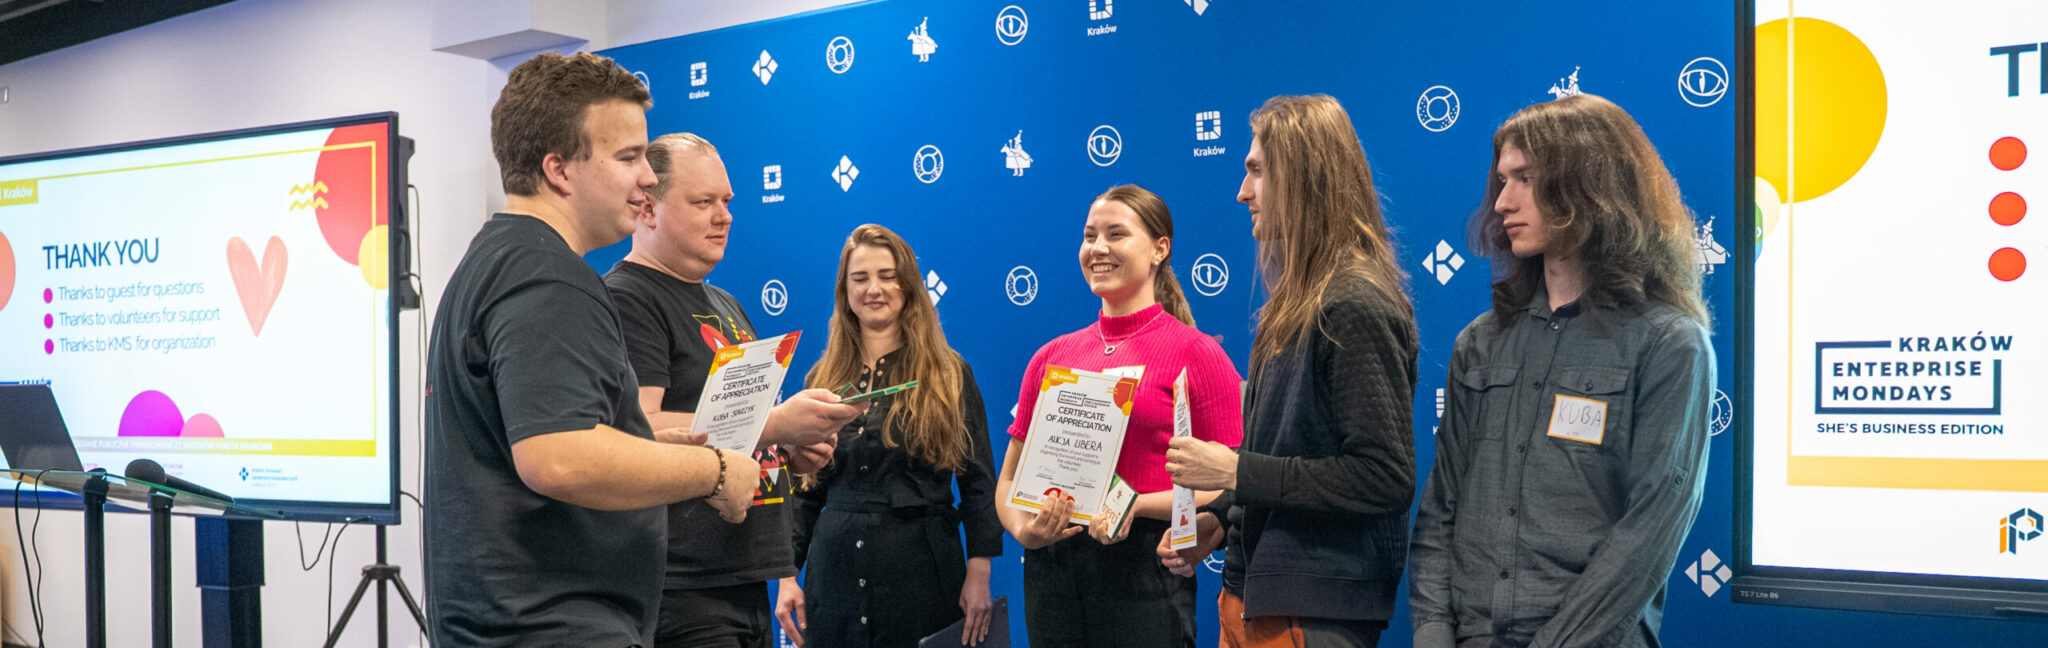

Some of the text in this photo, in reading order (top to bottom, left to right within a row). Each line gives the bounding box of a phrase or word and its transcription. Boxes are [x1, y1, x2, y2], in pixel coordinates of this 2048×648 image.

[1087, 24, 1117, 36] Kraków
[1990, 42, 2048, 97] T
[1193, 146, 1226, 157] Kraków
[3, 185, 33, 200] Kraków
[42, 237, 159, 270] THANK YOU
[58, 281, 205, 303] Thanks to guest for questions
[58, 306, 221, 327] Thanks to volunteers for support
[59, 335, 217, 354] Thanks to KMS for organization
[1898, 331, 2013, 352] KRAKÓW
[1832, 361, 1982, 377] ENTERPRISE
[711, 382, 771, 402] OF APPRECIATION
[722, 375, 766, 391] CERTIFICATE
[1832, 386, 1952, 401] MONDAYS
[1045, 414, 1112, 432] OF APPRECIATION
[1058, 406, 1106, 422] CERTIFICATE
[1558, 400, 1602, 428] KUBA
[1817, 422, 2004, 435] SHE'S BUSINESS EDITION
